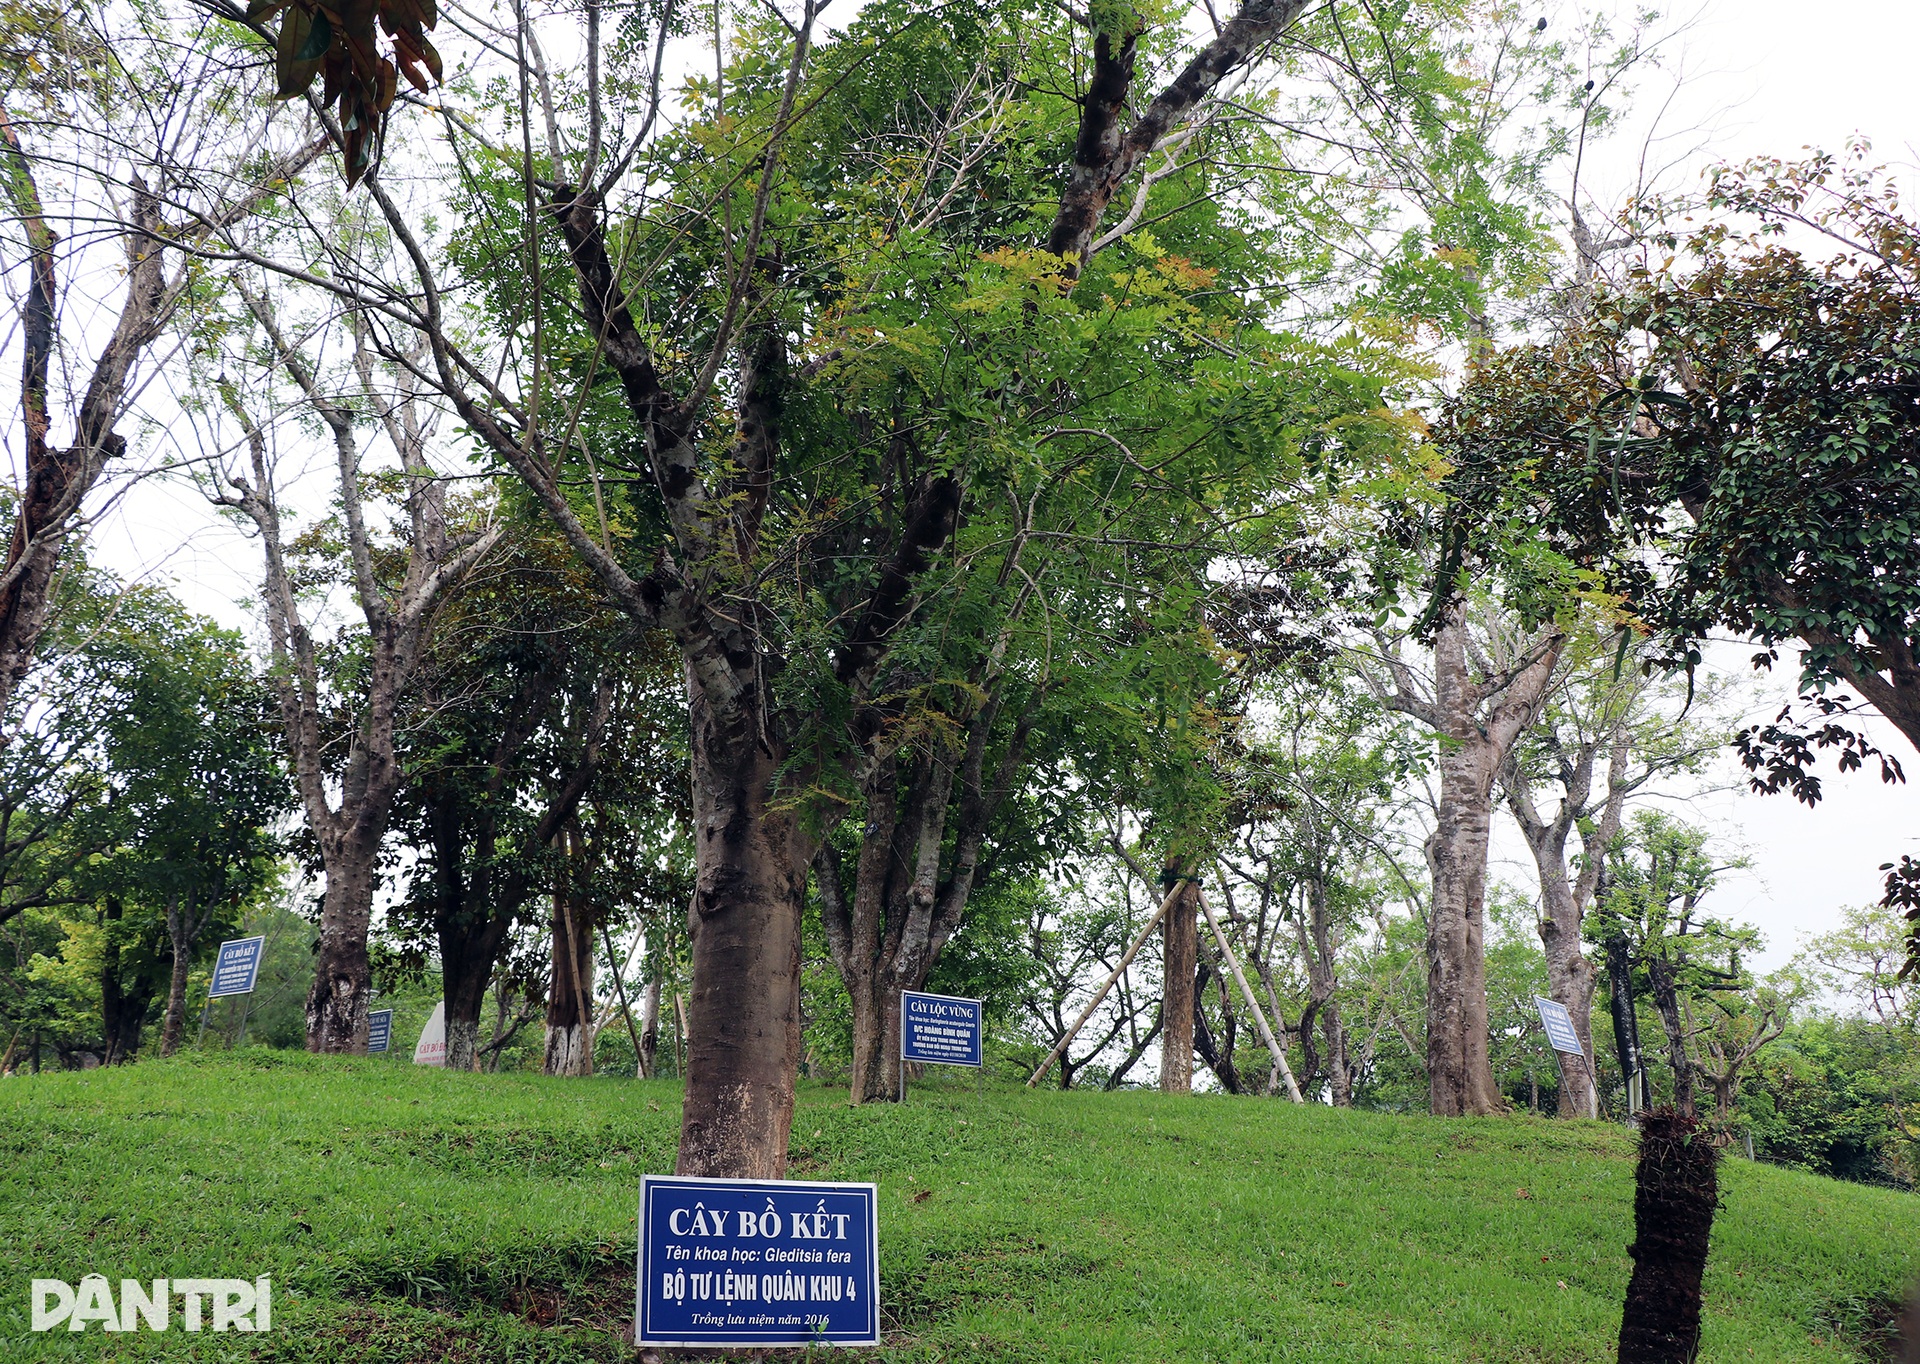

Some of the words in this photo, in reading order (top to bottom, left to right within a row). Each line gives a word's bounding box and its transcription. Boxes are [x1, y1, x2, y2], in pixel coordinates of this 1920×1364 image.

[911, 1000, 928, 1013] CÂY
[930, 1002, 948, 1017] LỘC
[949, 1004, 973, 1018] VỪNG
[924, 1026, 942, 1035] HOÀNG
[956, 1029, 970, 1038] QUÂN
[669, 1202, 730, 1237] CÂY
[738, 1197, 782, 1238] BỒ
[790, 1198, 850, 1240] KẾT
[665, 1245, 690, 1260] Tên
[694, 1246, 727, 1261] khoa
[731, 1247, 760, 1264] học:
[765, 1248, 822, 1263] Gleditsia
[826, 1248, 851, 1264] fera
[663, 1267, 686, 1306] BỘ
[691, 1270, 713, 1300] TƯ
[715, 1268, 756, 1306] LỆNH
[762, 1269, 805, 1304] QUÂN
[810, 1275, 842, 1301] KHU
[846, 1276, 856, 1301] 4
[691, 1311, 724, 1327] Trồng
[727, 1314, 745, 1325] lưu
[748, 1314, 775, 1327] niệm
[778, 1314, 801, 1325] năm
[804, 1314, 830, 1326] 2016
